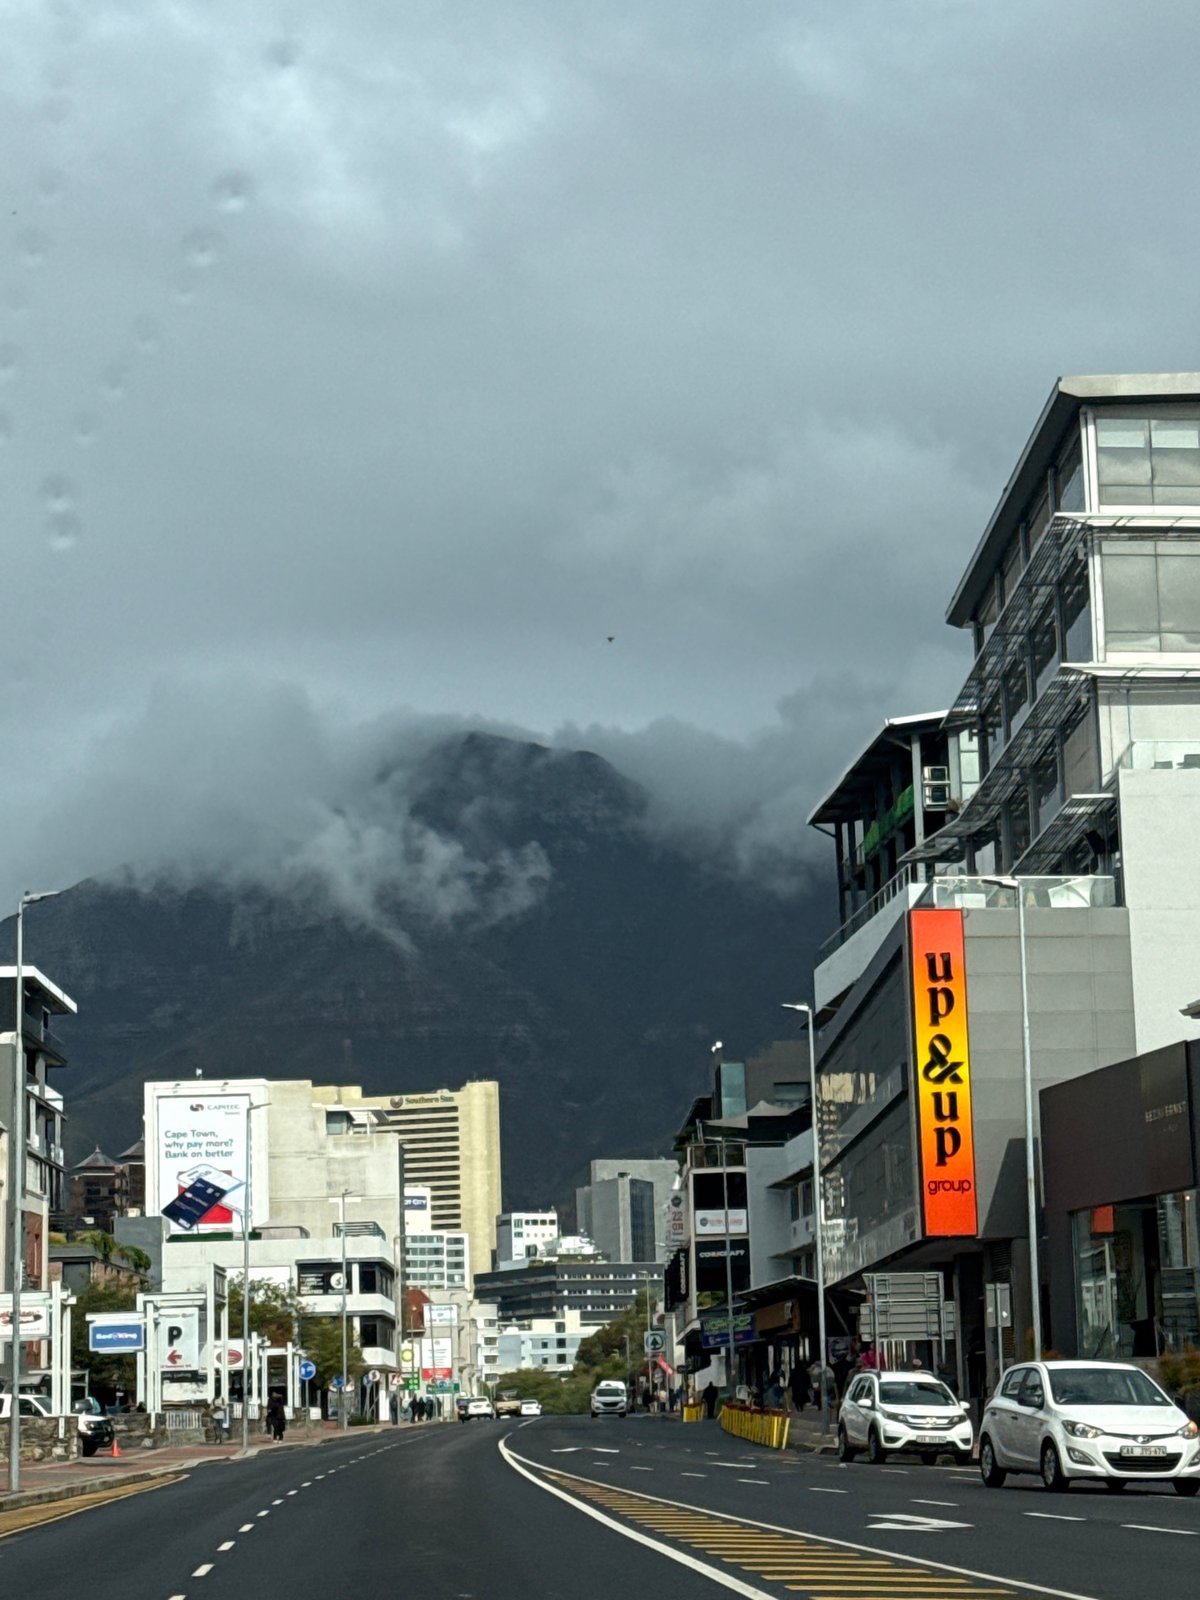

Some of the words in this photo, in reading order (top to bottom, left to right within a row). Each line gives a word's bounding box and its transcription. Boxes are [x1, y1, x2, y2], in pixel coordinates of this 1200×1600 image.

[440, 1094, 455, 1103] Sun
[164, 1130, 188, 1140] Cape
[190, 1129, 218, 1139] Town,
[164, 1141, 184, 1149] why
[187, 1141, 203, 1150] pay
[205, 1138, 234, 1148] more?
[165, 1150, 188, 1159] Bank
[205, 1149, 234, 1158] better
[927, 1178, 972, 1196] group
[168, 1326, 182, 1347] P
